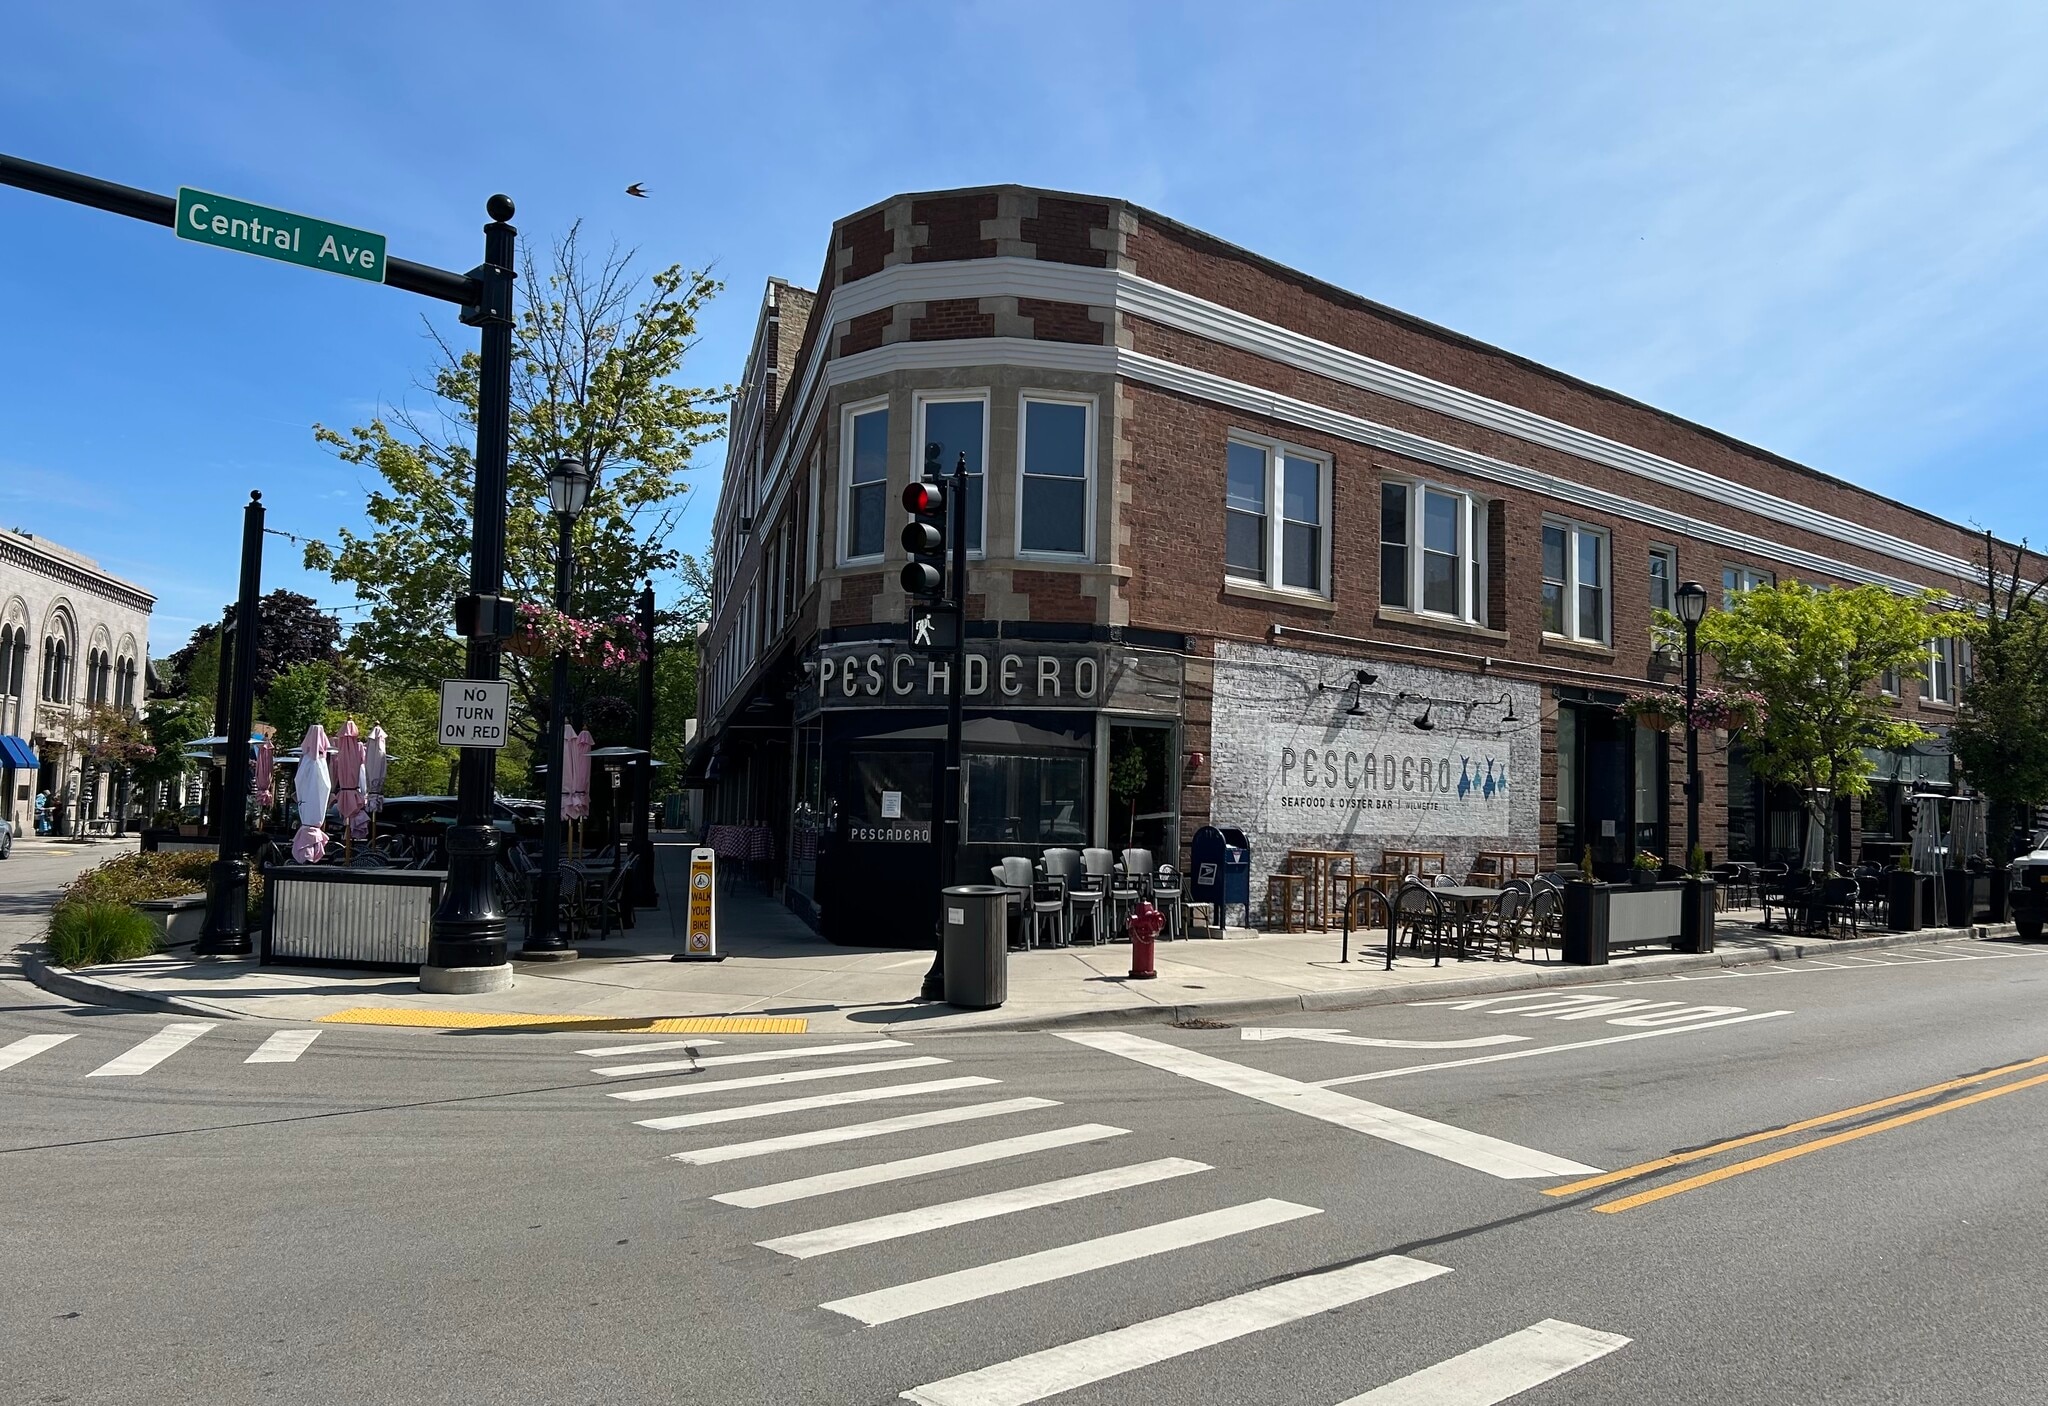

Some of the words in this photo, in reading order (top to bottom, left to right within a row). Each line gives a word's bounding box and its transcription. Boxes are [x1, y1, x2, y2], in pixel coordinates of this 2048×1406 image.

[189, 203, 300, 252] Central
[318, 234, 376, 269] Ave
[819, 653, 1098, 698] PESCADERO
[464, 689, 487, 702] NO
[456, 706, 494, 720] TURN
[445, 724, 465, 738] ON
[473, 726, 500, 739] RED
[1281, 747, 1451, 794] PESCADERO
[1281, 796, 1325, 808] SEAFOOD
[1329, 798, 1335, 808] &
[1339, 798, 1373, 809] OYSTER
[1376, 799, 1393, 810] BAR
[851, 828, 929, 842] PESCADERO
[691, 892, 711, 901] WALK
[691, 906, 710, 915] YOUR
[692, 921, 708, 930] BIKE
[1406, 992, 1748, 1027] ONLY
